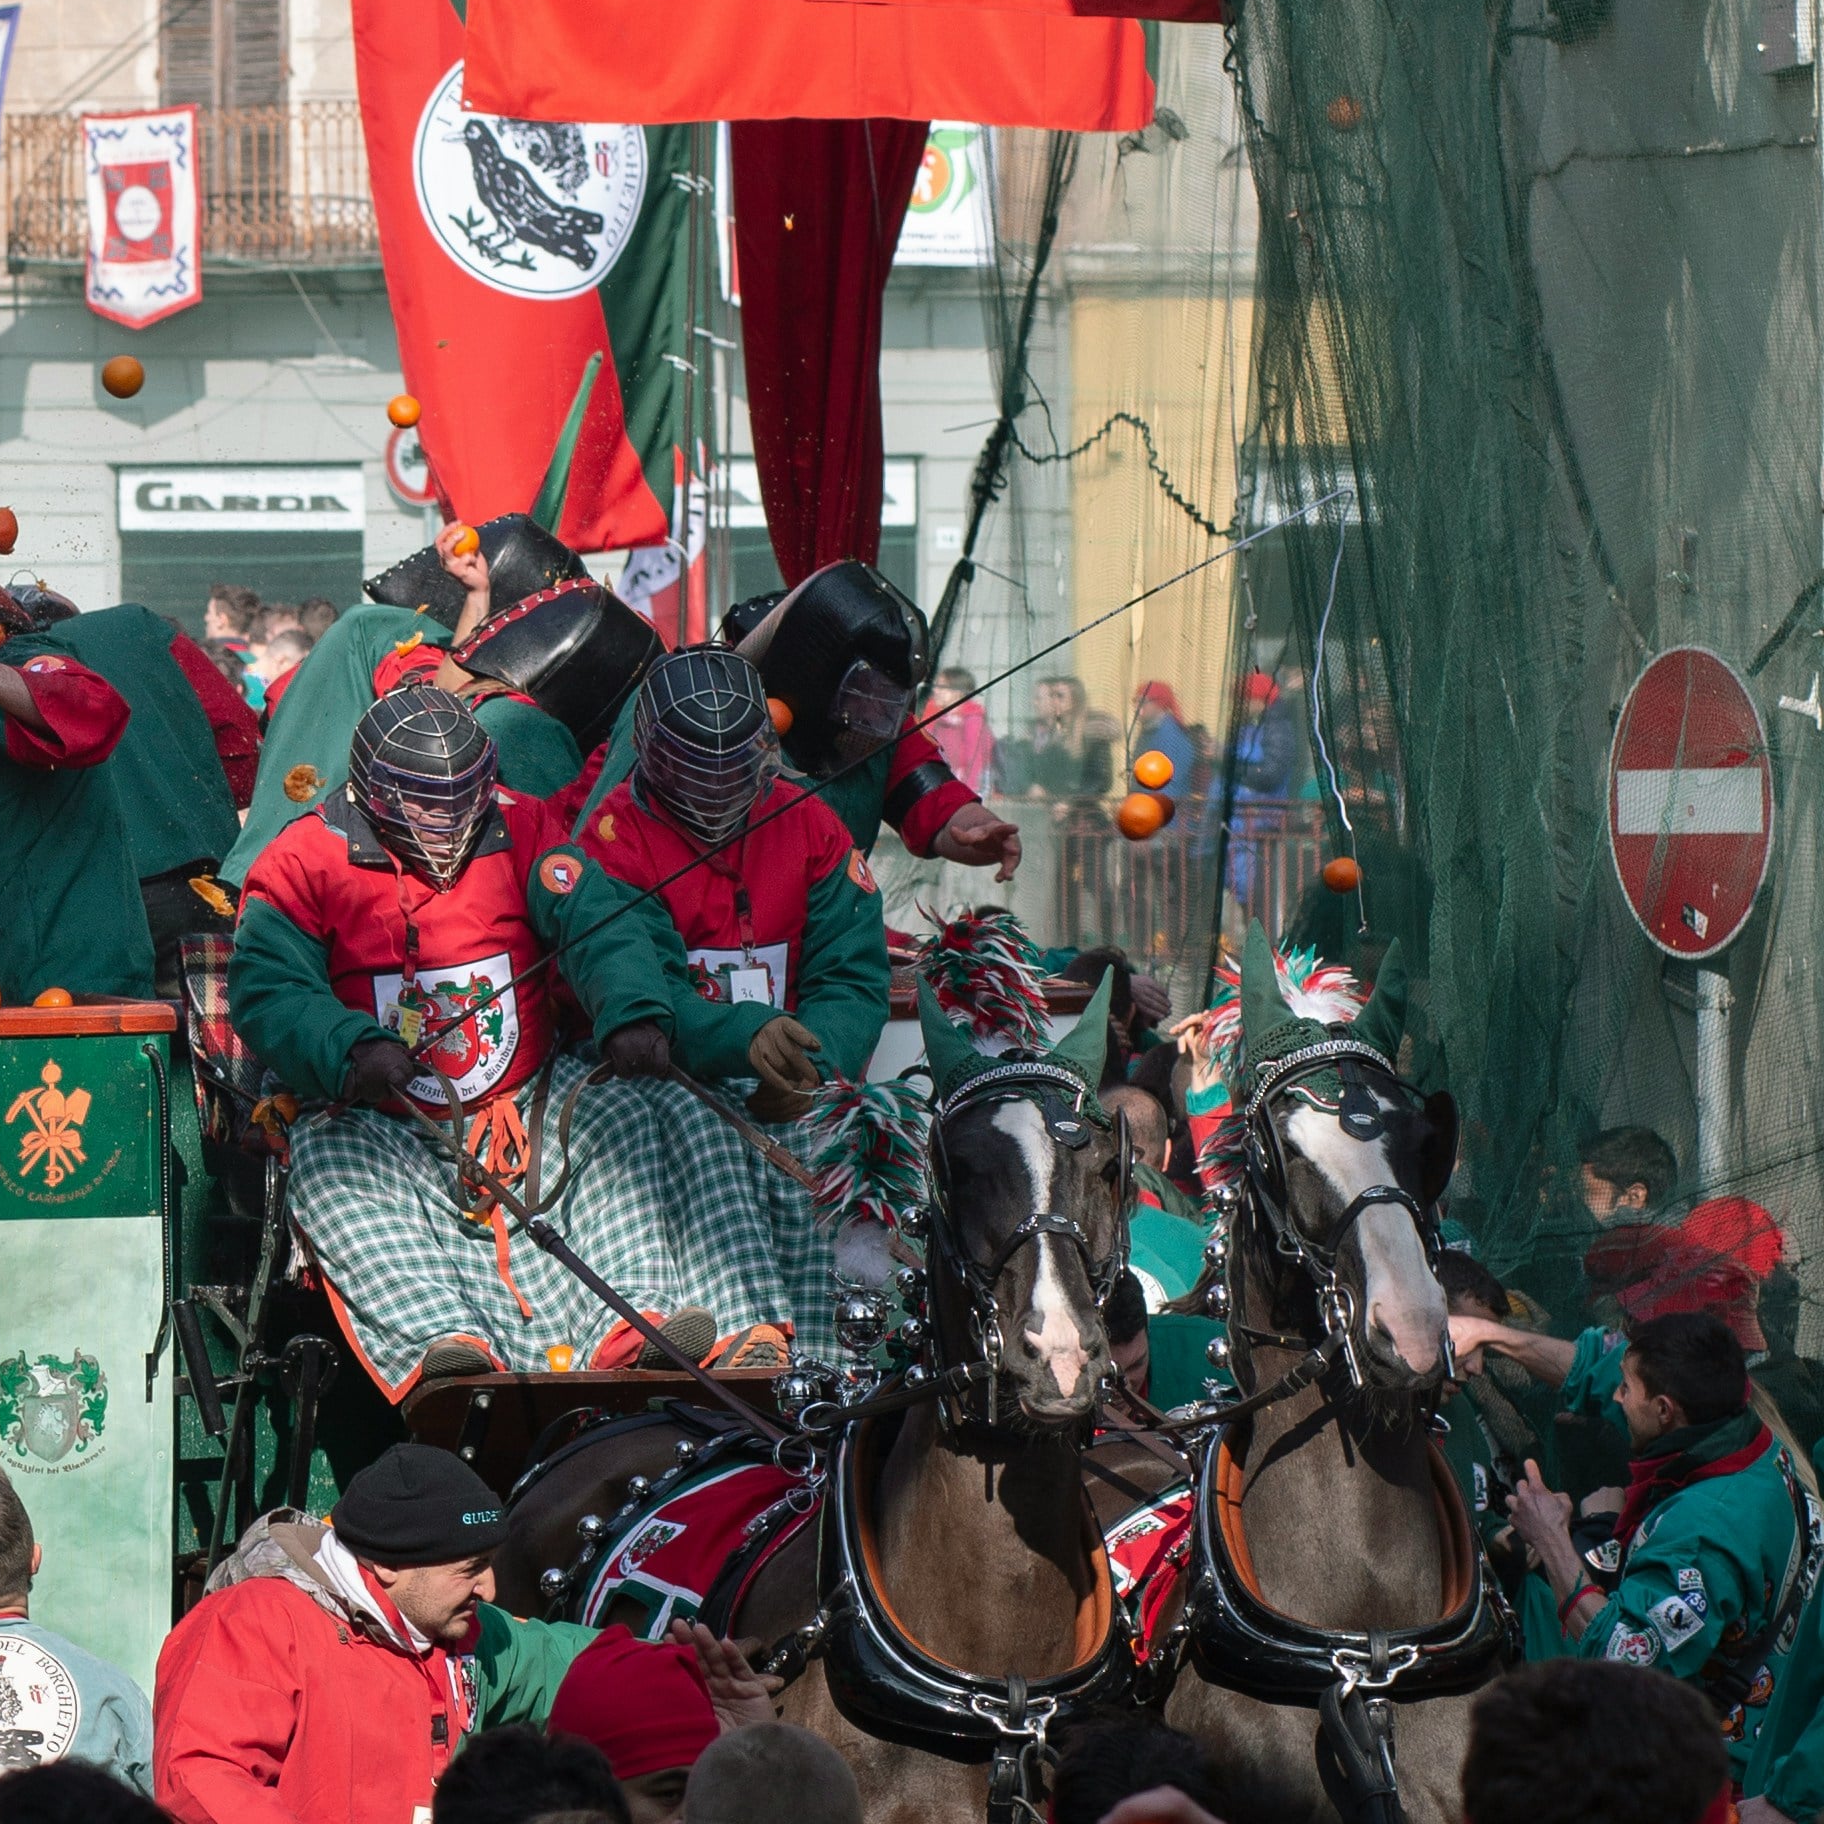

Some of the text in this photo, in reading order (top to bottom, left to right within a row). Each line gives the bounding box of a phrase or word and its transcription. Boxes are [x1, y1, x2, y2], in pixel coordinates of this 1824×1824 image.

[134, 479, 349, 513] GARDA
[482, 1028, 518, 1084] Biandrate
[34, 1656, 74, 1754] BORGHETTO
